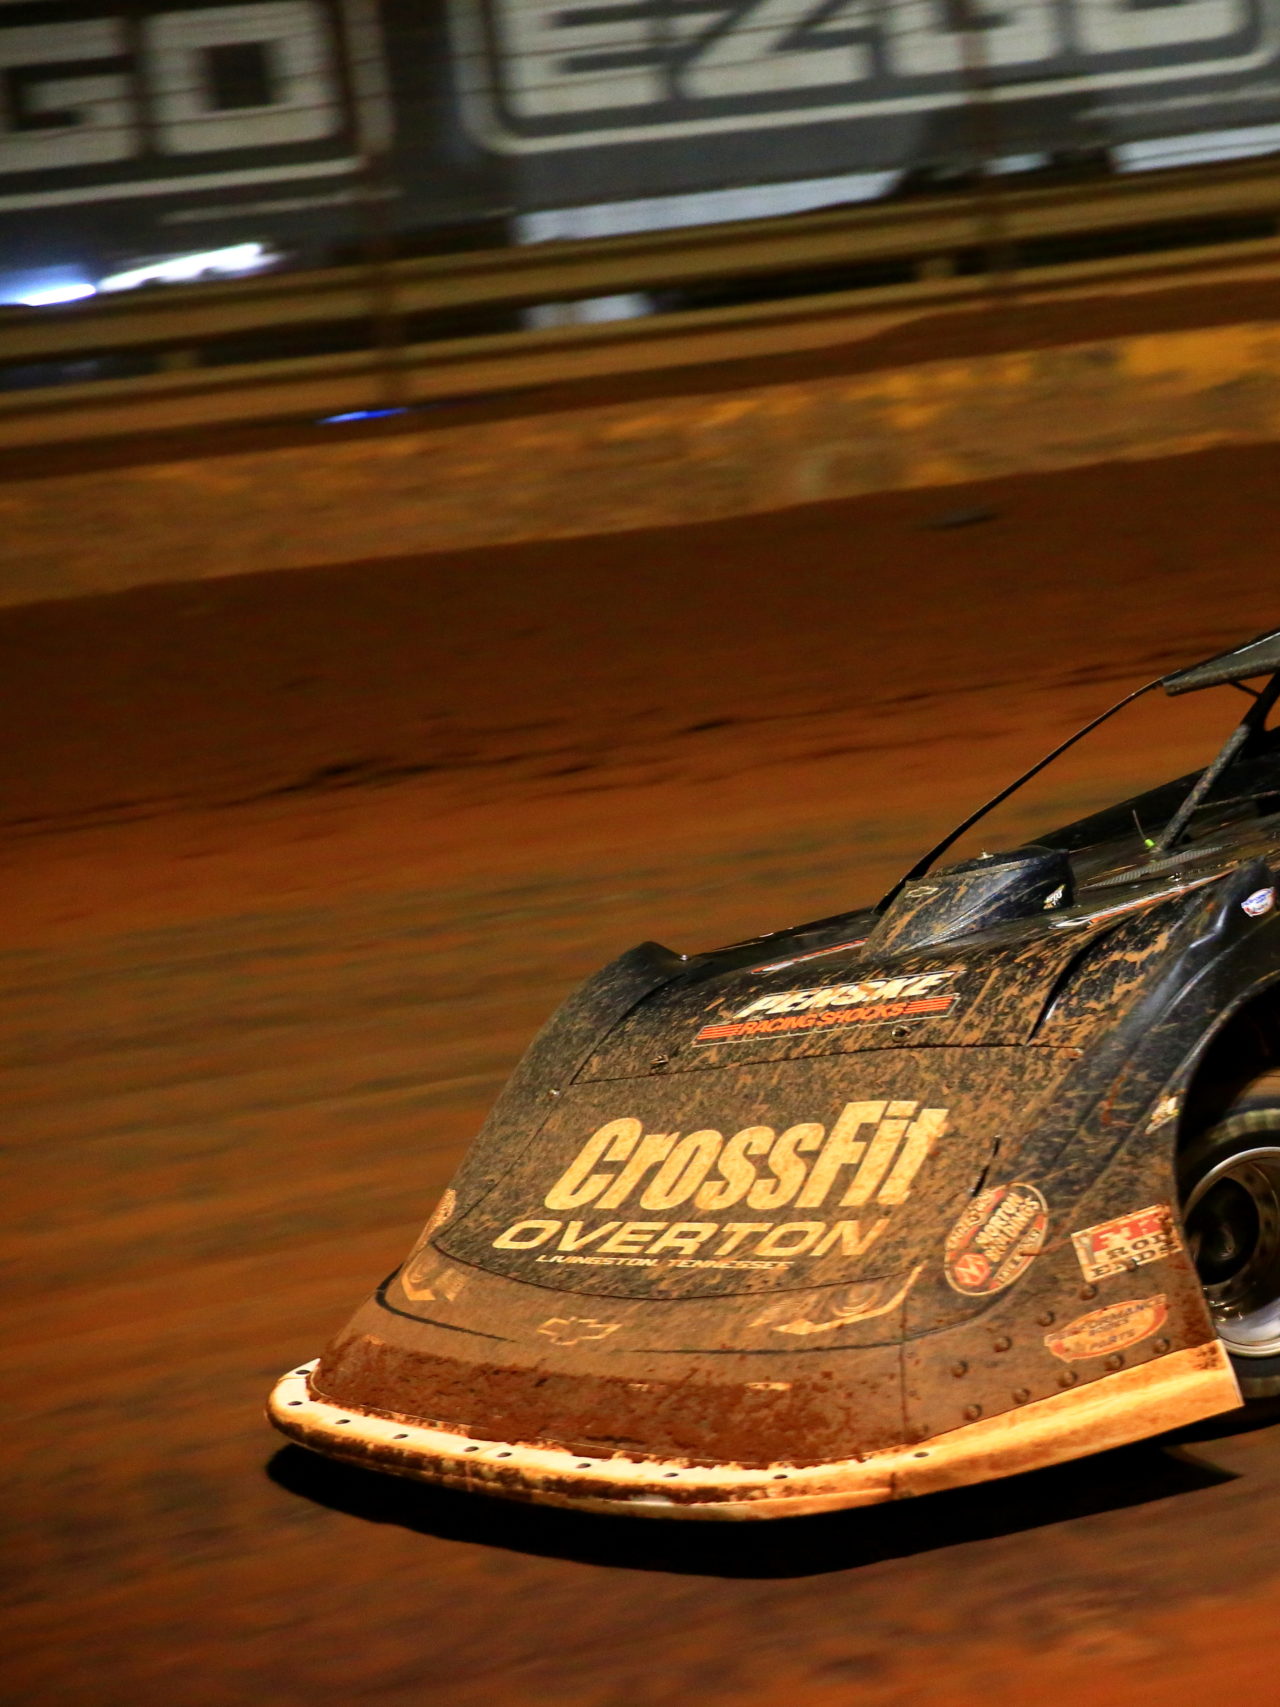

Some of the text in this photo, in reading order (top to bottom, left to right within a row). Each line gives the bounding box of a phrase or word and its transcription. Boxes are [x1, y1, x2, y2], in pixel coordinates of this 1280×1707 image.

[733, 972, 955, 1018] PENSKE
[737, 1002, 908, 1036] RACING SHOCKS
[544, 1101, 948, 1210] CrossFit
[493, 1218, 890, 1257] OVERTON
[667, 1258, 796, 1270] TENNESSEE
